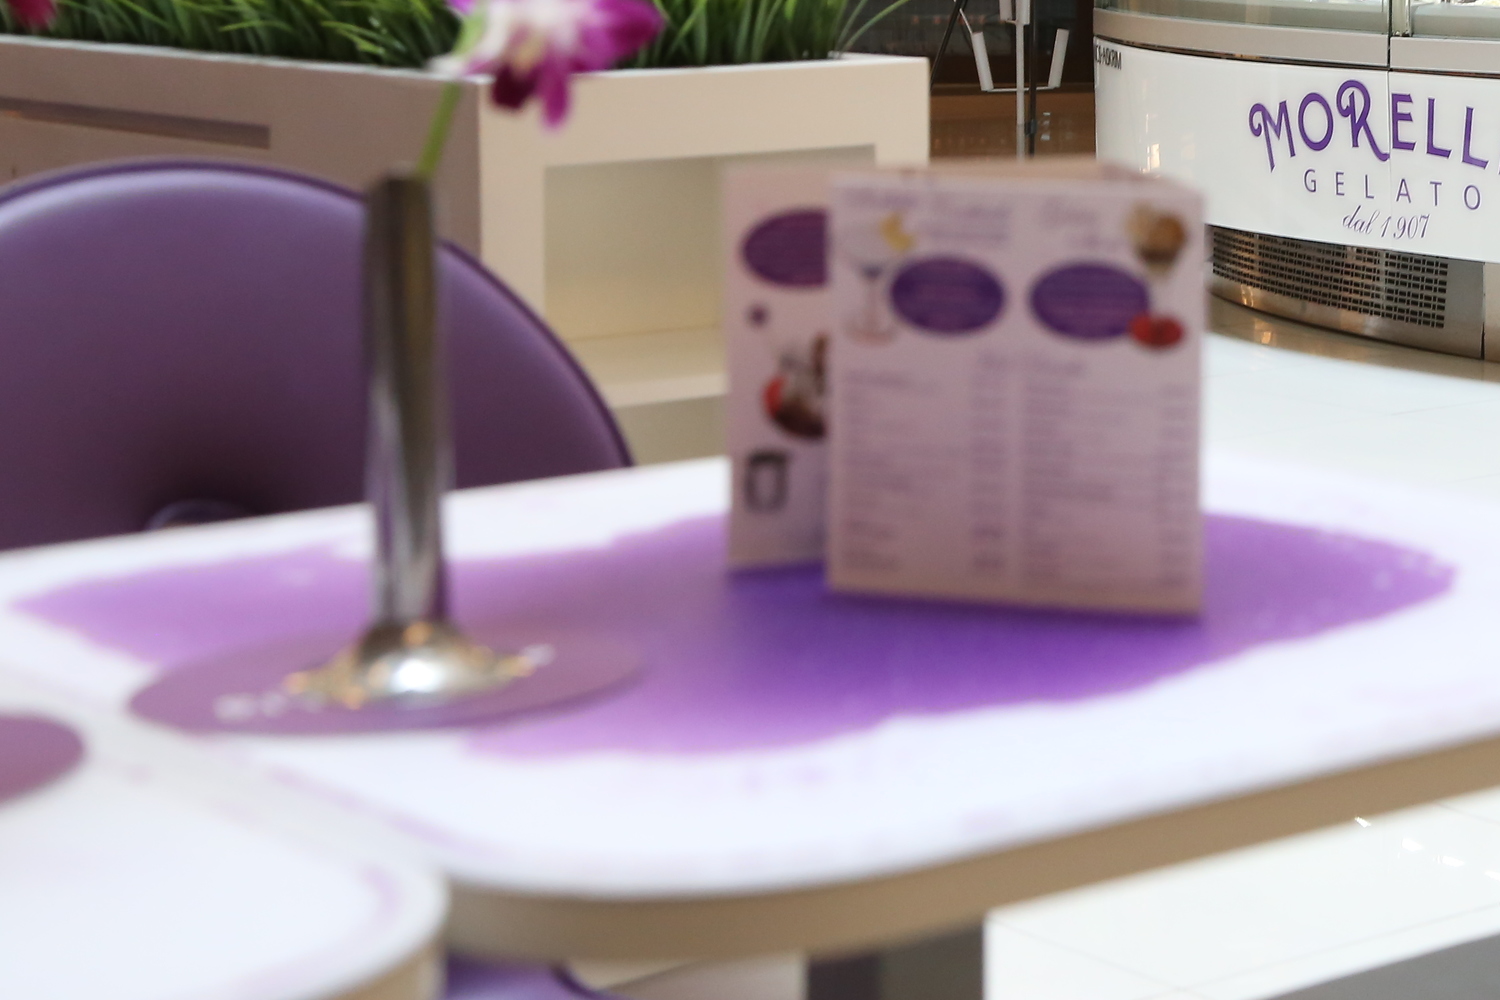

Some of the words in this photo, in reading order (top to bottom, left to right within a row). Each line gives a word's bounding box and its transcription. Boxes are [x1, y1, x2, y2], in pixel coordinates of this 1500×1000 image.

[1304, 169, 1481, 210] GELATO
[1342, 205, 1380, 235] dal
[1381, 213, 1430, 240] 1907
